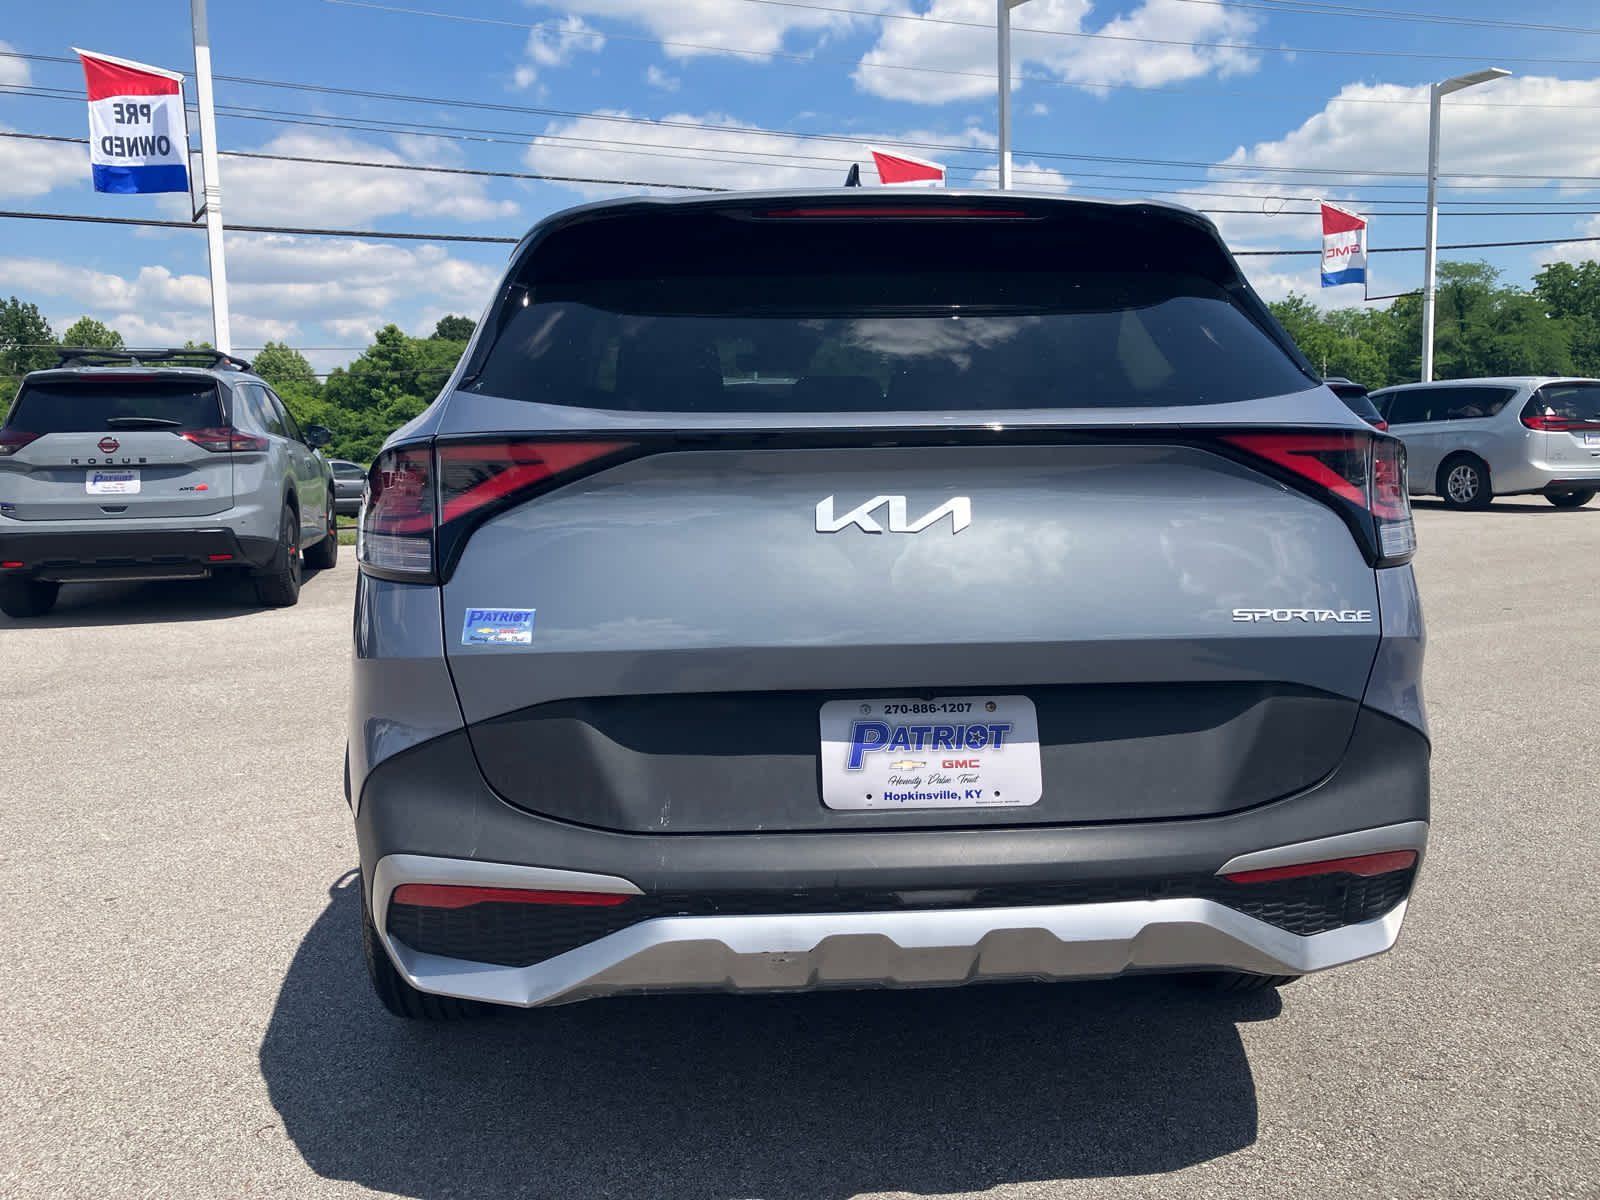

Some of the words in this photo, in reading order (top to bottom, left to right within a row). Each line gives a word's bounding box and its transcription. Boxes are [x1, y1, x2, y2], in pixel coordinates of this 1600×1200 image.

[70, 457, 147, 465] ROGUE
[815, 495, 971, 535] KIA
[467, 611, 531, 627] PATRIOT
[1232, 608, 1373, 623] SPORTAGE
[884, 703, 973, 715] 270-886-1207
[847, 721, 1010, 770] PATRIOT
[942, 759, 981, 769] GMC
[884, 790, 962, 802] Hopkinsville,
[965, 789, 982, 799] KY
